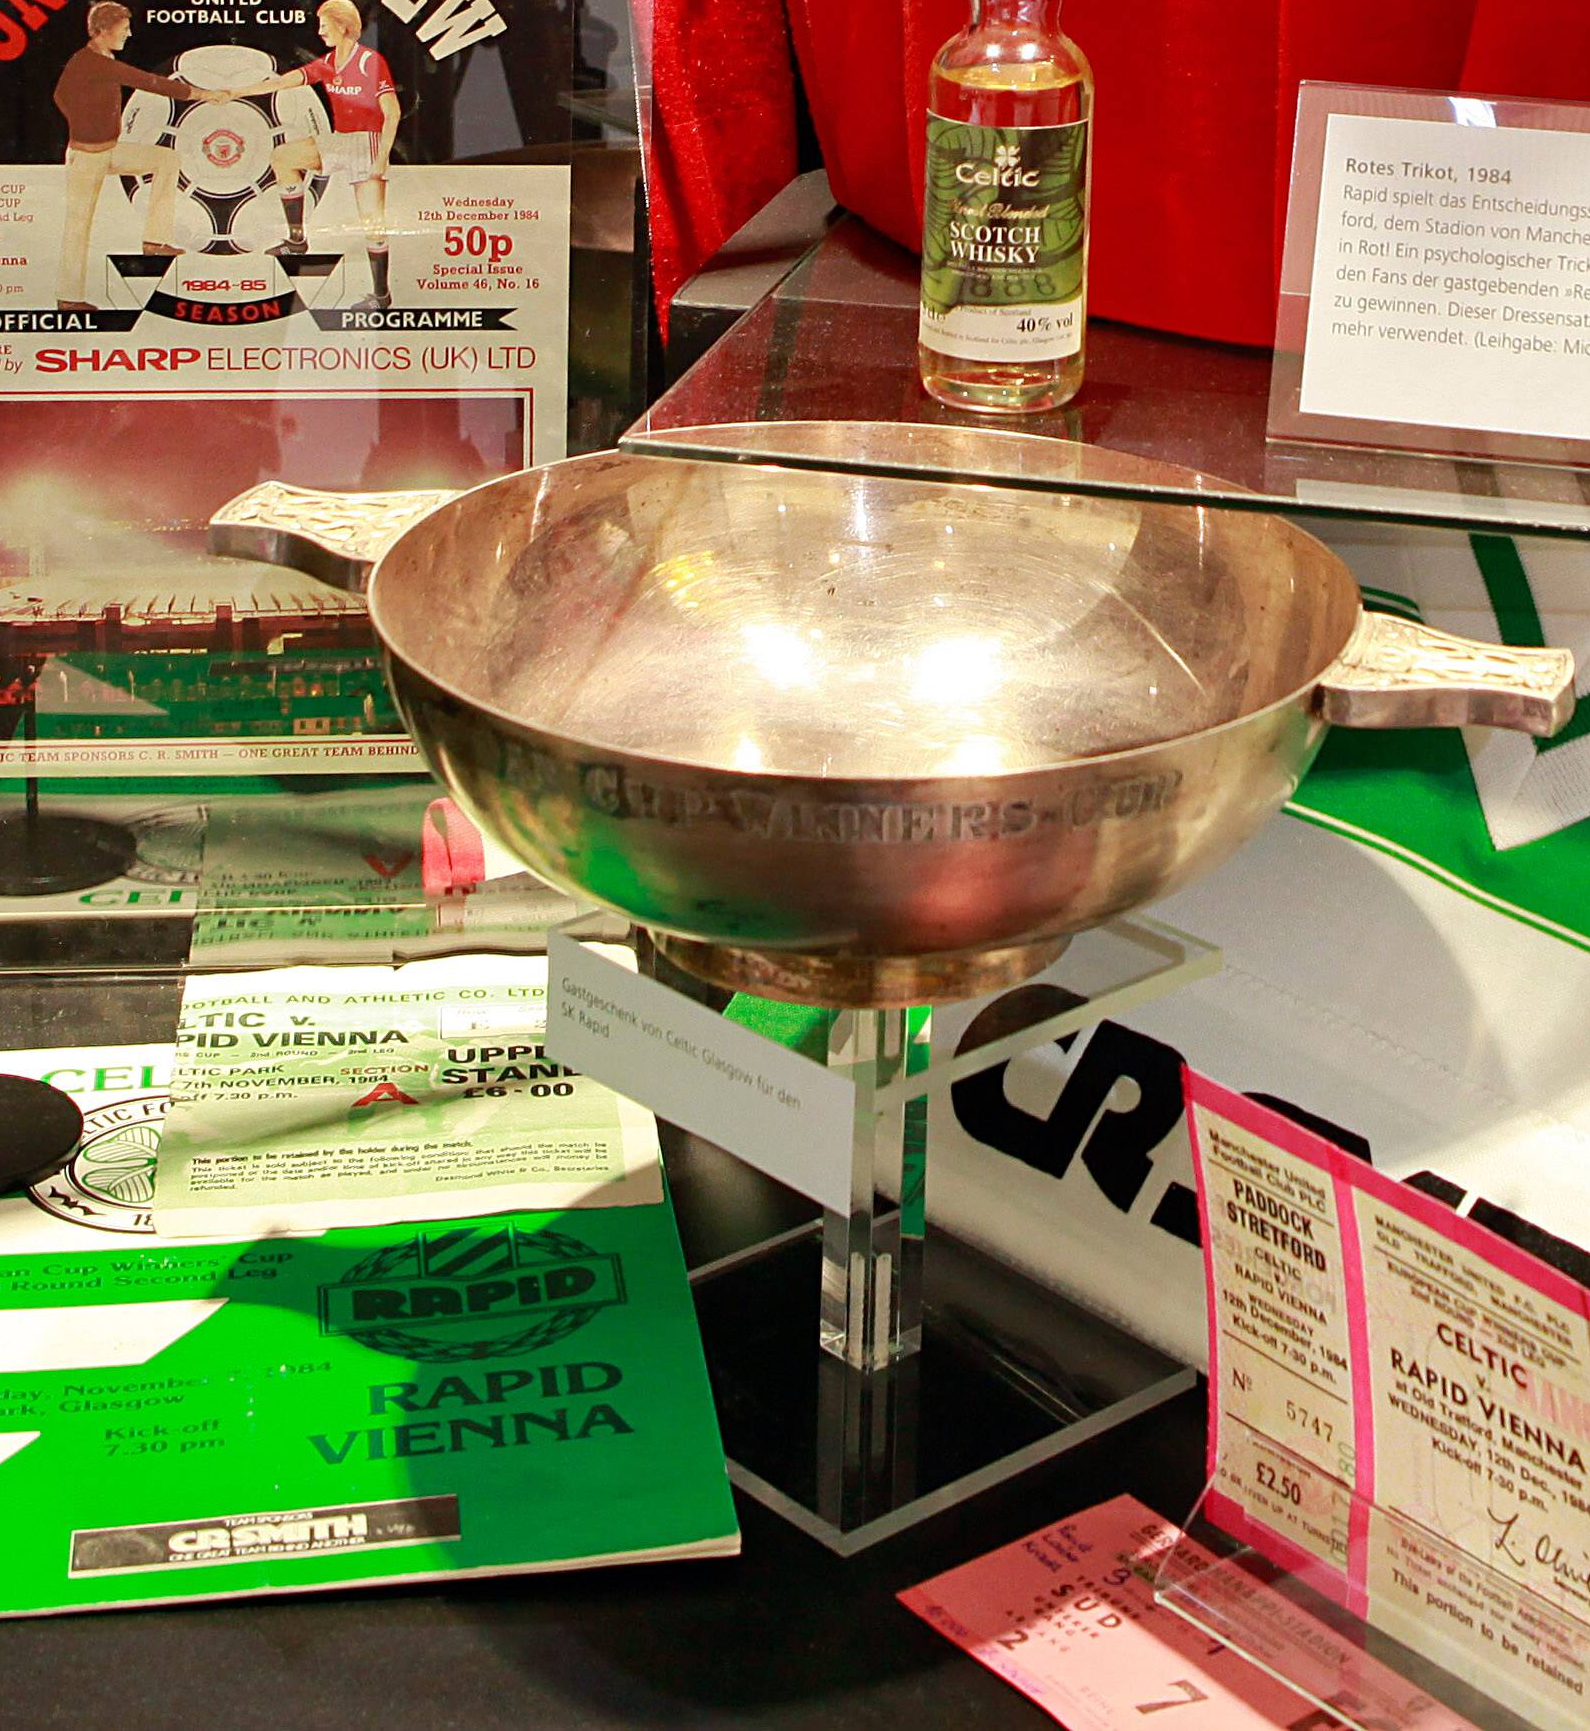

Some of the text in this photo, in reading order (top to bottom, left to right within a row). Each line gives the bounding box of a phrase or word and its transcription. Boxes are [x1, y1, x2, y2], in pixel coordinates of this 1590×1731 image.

[146, 9, 306, 25] FOOTBALL CLUB
[955, 162, 1041, 188] Celtic
[1345, 157, 1511, 184] Rotes Trikot, 1984
[0, 184, 26, 195] CUP
[1343, 184, 1388, 205] Rapid
[1392, 189, 1434, 208] spielt
[1438, 191, 1466, 209] das
[418, 209, 540, 221] 12th December 1984
[442, 196, 515, 209] Wednesday
[443, 225, 514, 263] 50p
[950, 220, 1041, 245] SCOTCH
[950, 240, 1040, 264] WHISKY
[433, 263, 523, 277] Special Issue
[181, 279, 267, 293] 1984-85
[416, 278, 540, 292] Volume 46, No. 16
[174, 300, 282, 323] SEASON
[341, 311, 484, 329] PROGRAMME
[1016, 312, 1074, 334] 40% vol
[4, 359, 24, 376] by
[35, 345, 537, 374] SHARP ELECTRONICS (UK) LTD
[19, 750, 60, 763] TEAM
[63, 749, 135, 762] SPONSORS
[138, 750, 153, 761] C.
[156, 749, 171, 761] R.
[174, 748, 219, 761] SMITH
[237, 747, 268, 759] ONE
[271, 746, 318, 759] GREAT
[323, 745, 365, 758] TEAM
[367, 744, 421, 757] BEHIND
[561, 1000, 609, 1038] SK Rapid
[252, 1029, 409, 1048] VIENNA
[561, 976, 800, 1108] Gastgeschenk von Celtic Glasgow für den
[220, 1075, 341, 1089] NOVEMBER,
[347, 1074, 389, 1085] 1984
[339, 1063, 429, 1076] SECTION
[350, 1081, 420, 1107] A
[1232, 1178, 1313, 1240] PADDOCK
[1226, 1200, 1326, 1271] STRETFORD
[42, 1262, 98, 1281] Cup
[238, 1248, 294, 1268] Cup
[350, 1266, 599, 1322] RAPID
[1436, 1322, 1528, 1390] CELTIC
[366, 1360, 625, 1418] RAPID
[1285, 1399, 1333, 1442] 5747
[1390, 1347, 1586, 1474] RAPID VIENNA
[308, 1403, 636, 1466] VIENNA
[1256, 1461, 1301, 1506] £2.50
